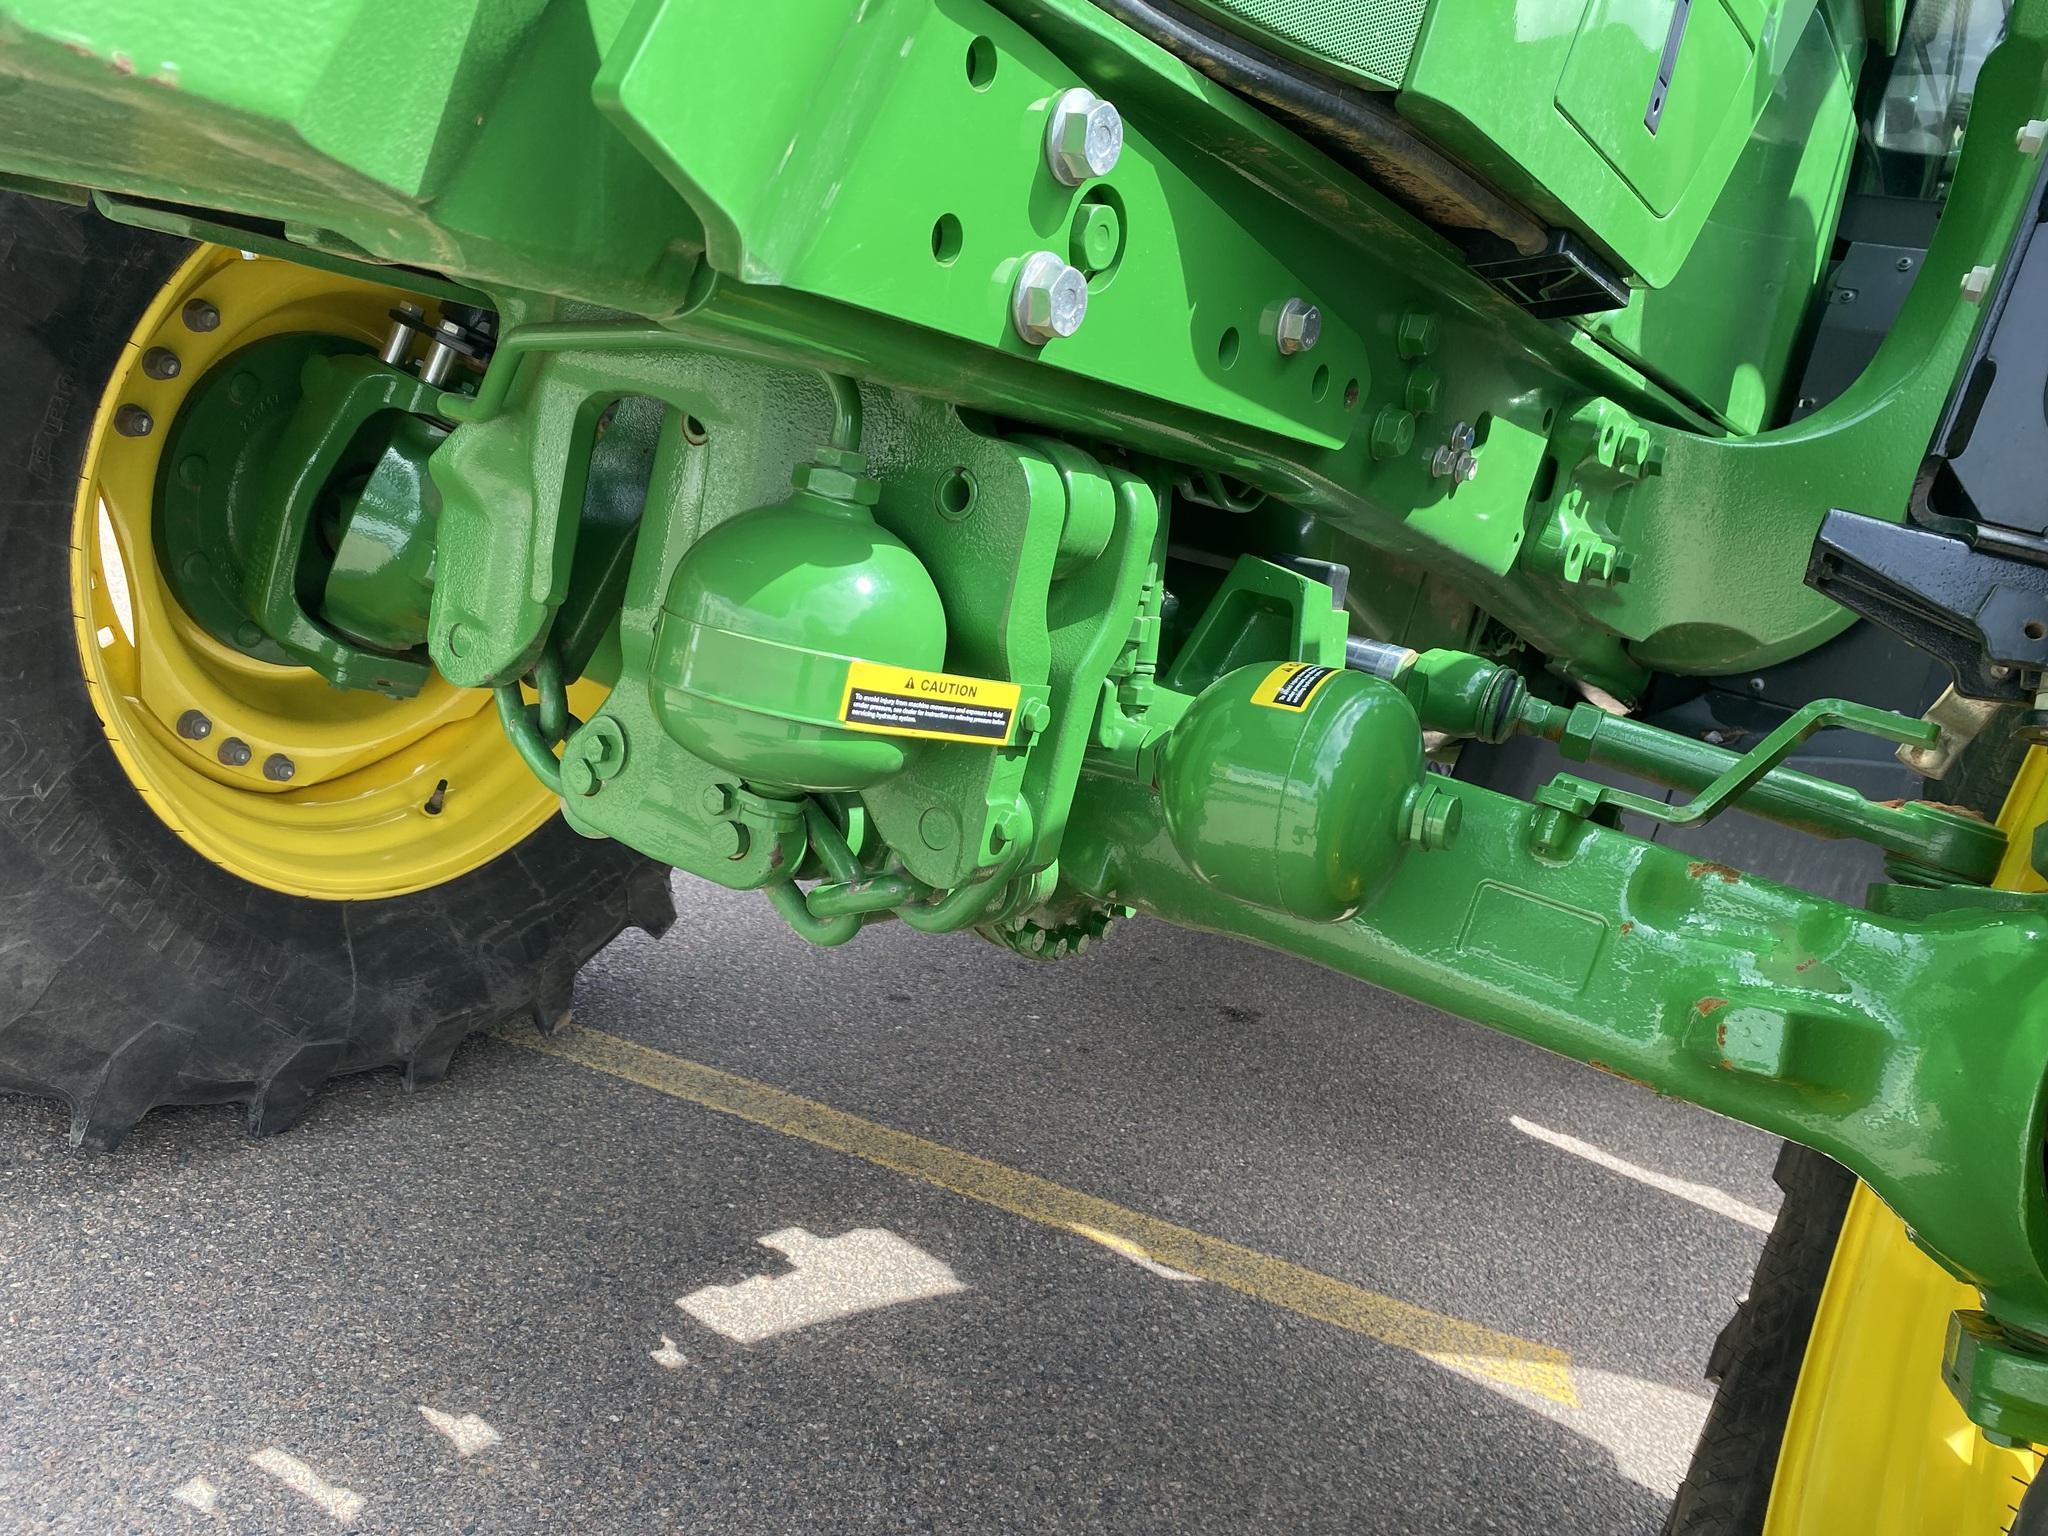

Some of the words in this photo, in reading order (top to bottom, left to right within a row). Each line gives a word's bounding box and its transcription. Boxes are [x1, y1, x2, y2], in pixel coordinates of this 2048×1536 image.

[921, 679, 978, 698] CAUTION
[855, 692, 863, 700] To
[863, 695, 880, 703] avoid
[880, 696, 896, 706] injury
[895, 698, 908, 707] from
[907, 701, 930, 709] machine
[851, 709, 876, 719] servicing
[875, 712, 898, 721] hydraulic
[852, 701, 870, 709] under
[902, 707, 918, 716] dealer
[917, 709, 925, 717] for
